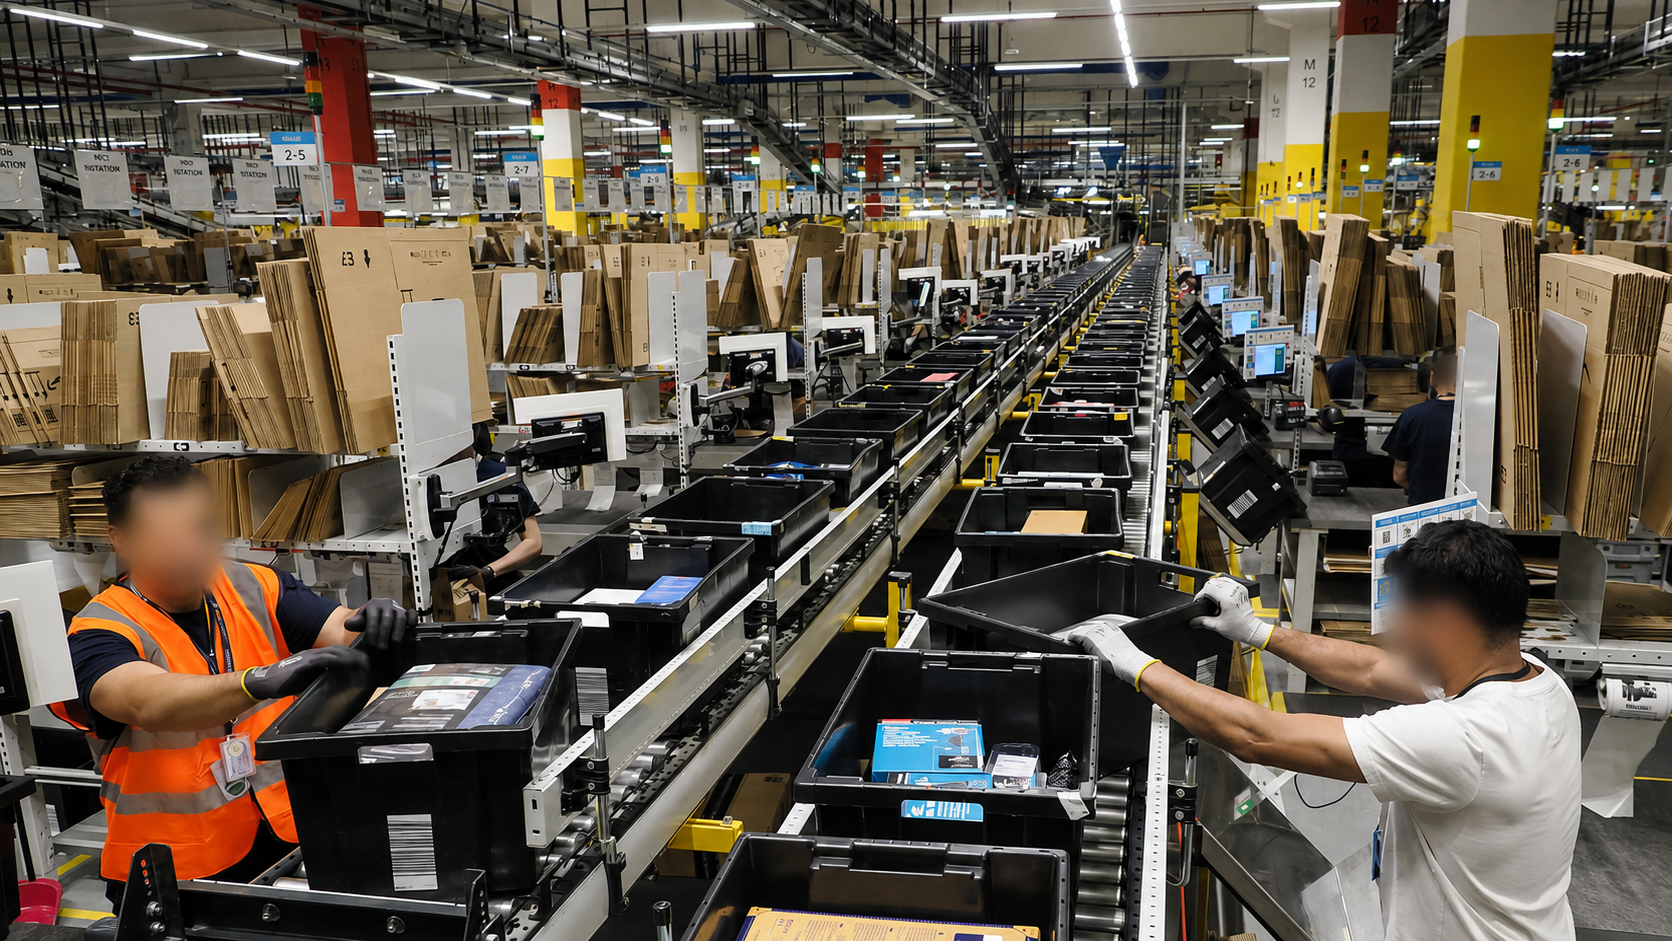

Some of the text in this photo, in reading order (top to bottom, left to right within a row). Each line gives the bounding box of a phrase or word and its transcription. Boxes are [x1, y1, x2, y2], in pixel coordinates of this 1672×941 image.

[1361, 16, 1379, 33] 12
[1304, 59, 1316, 70] M
[1302, 77, 1316, 88] 12
[284, 149, 306, 161] 2-5
[1563, 158, 1580, 168] 2-6
[514, 166, 530, 174] 2-7
[1479, 170, 1496, 179] 2-6
